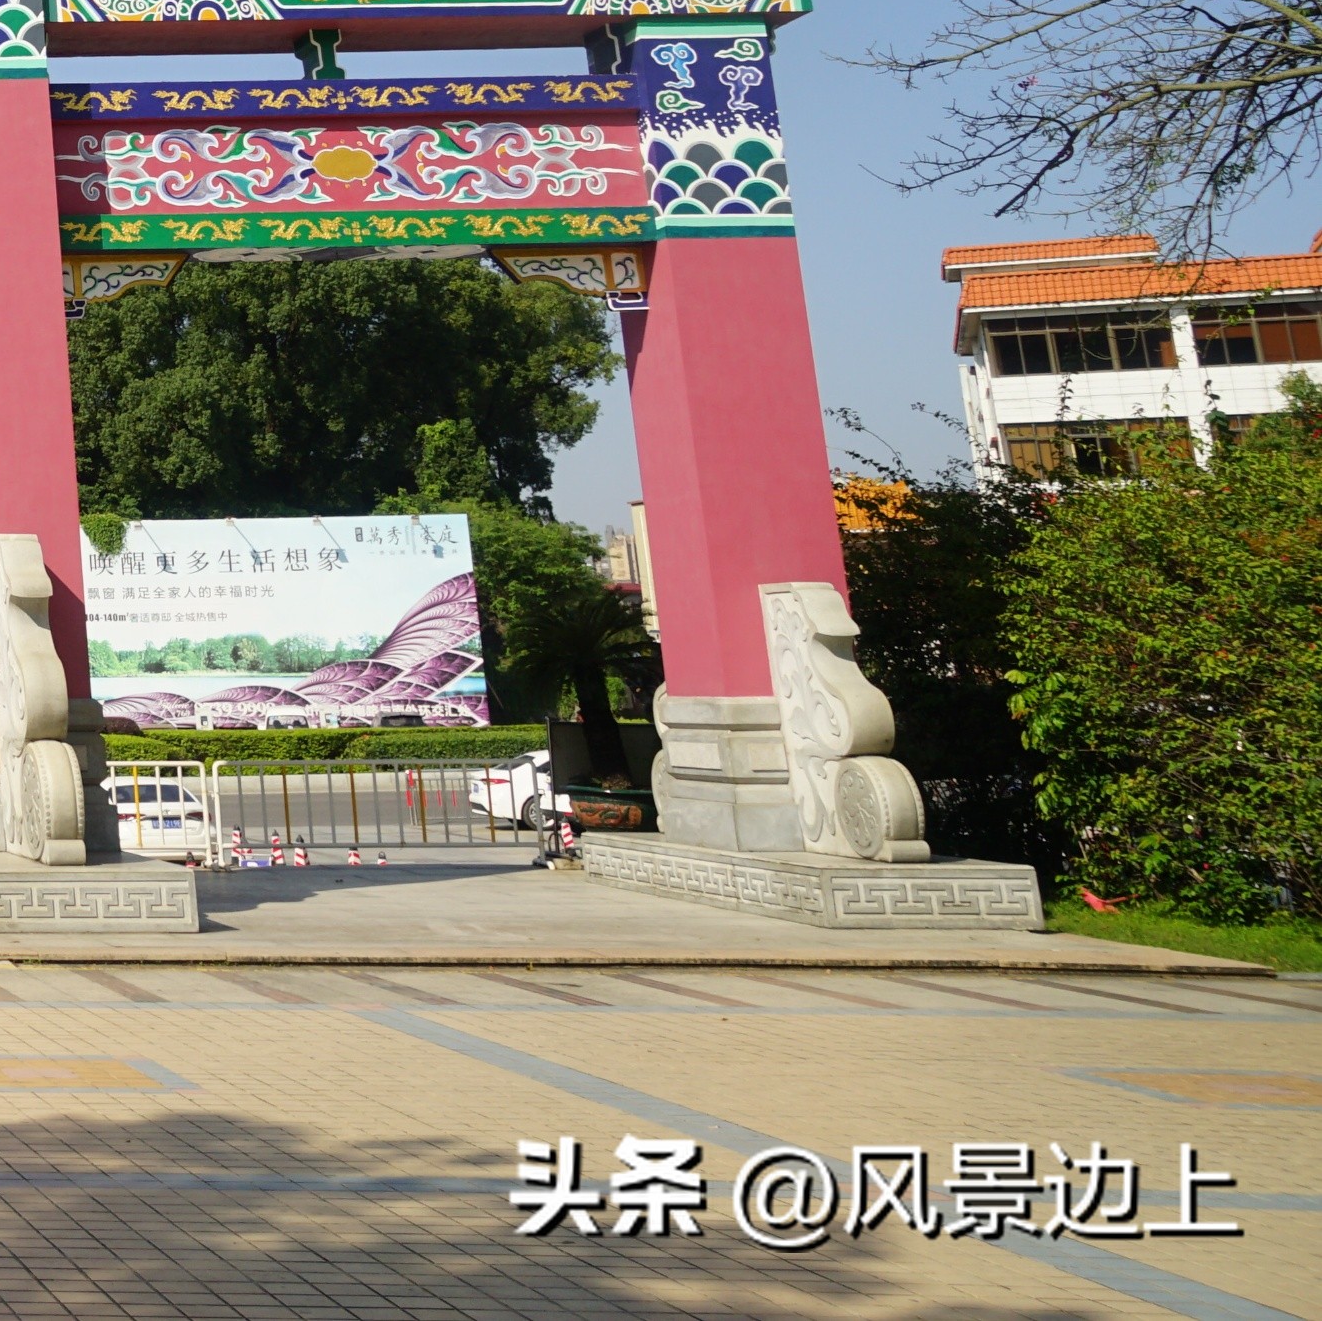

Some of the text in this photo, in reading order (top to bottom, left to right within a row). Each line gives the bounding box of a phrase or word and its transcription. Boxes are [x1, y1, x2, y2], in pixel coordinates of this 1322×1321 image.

[89, 546, 344, 576] 唤醒更多生活想象
[87, 584, 275, 600] 飘窗 满足全家人的幸福时光
